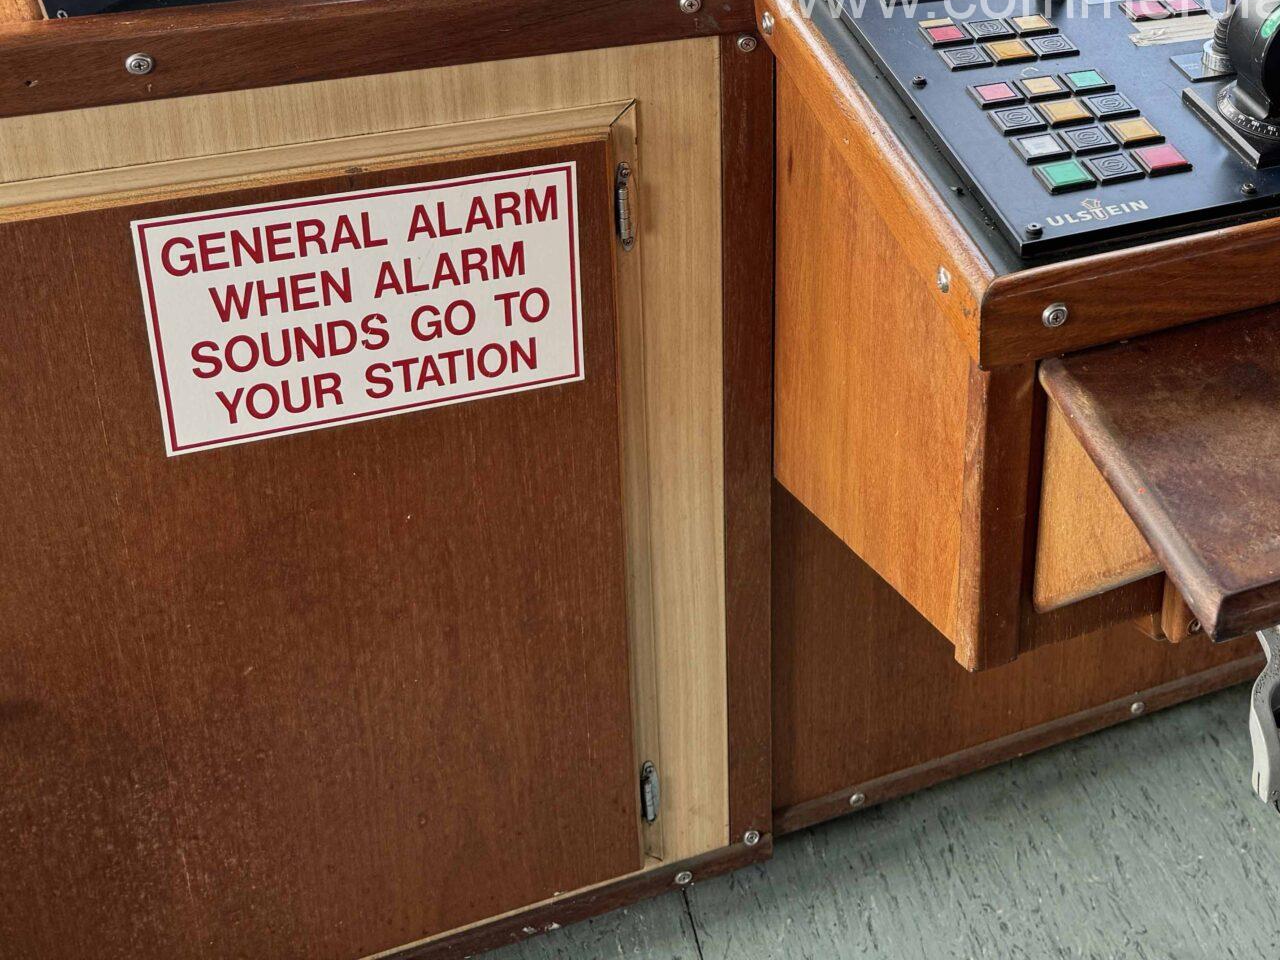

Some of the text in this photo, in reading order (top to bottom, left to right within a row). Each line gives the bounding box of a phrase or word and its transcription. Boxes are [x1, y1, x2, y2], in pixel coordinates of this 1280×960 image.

[161, 185, 559, 276] GENERAL ALARM
[1045, 199, 1150, 227] ULSTEIN
[209, 241, 526, 323] WHEN ALARM
[191, 287, 550, 379] SOUNDS GO TO
[215, 337, 538, 424] YOUR STATION
